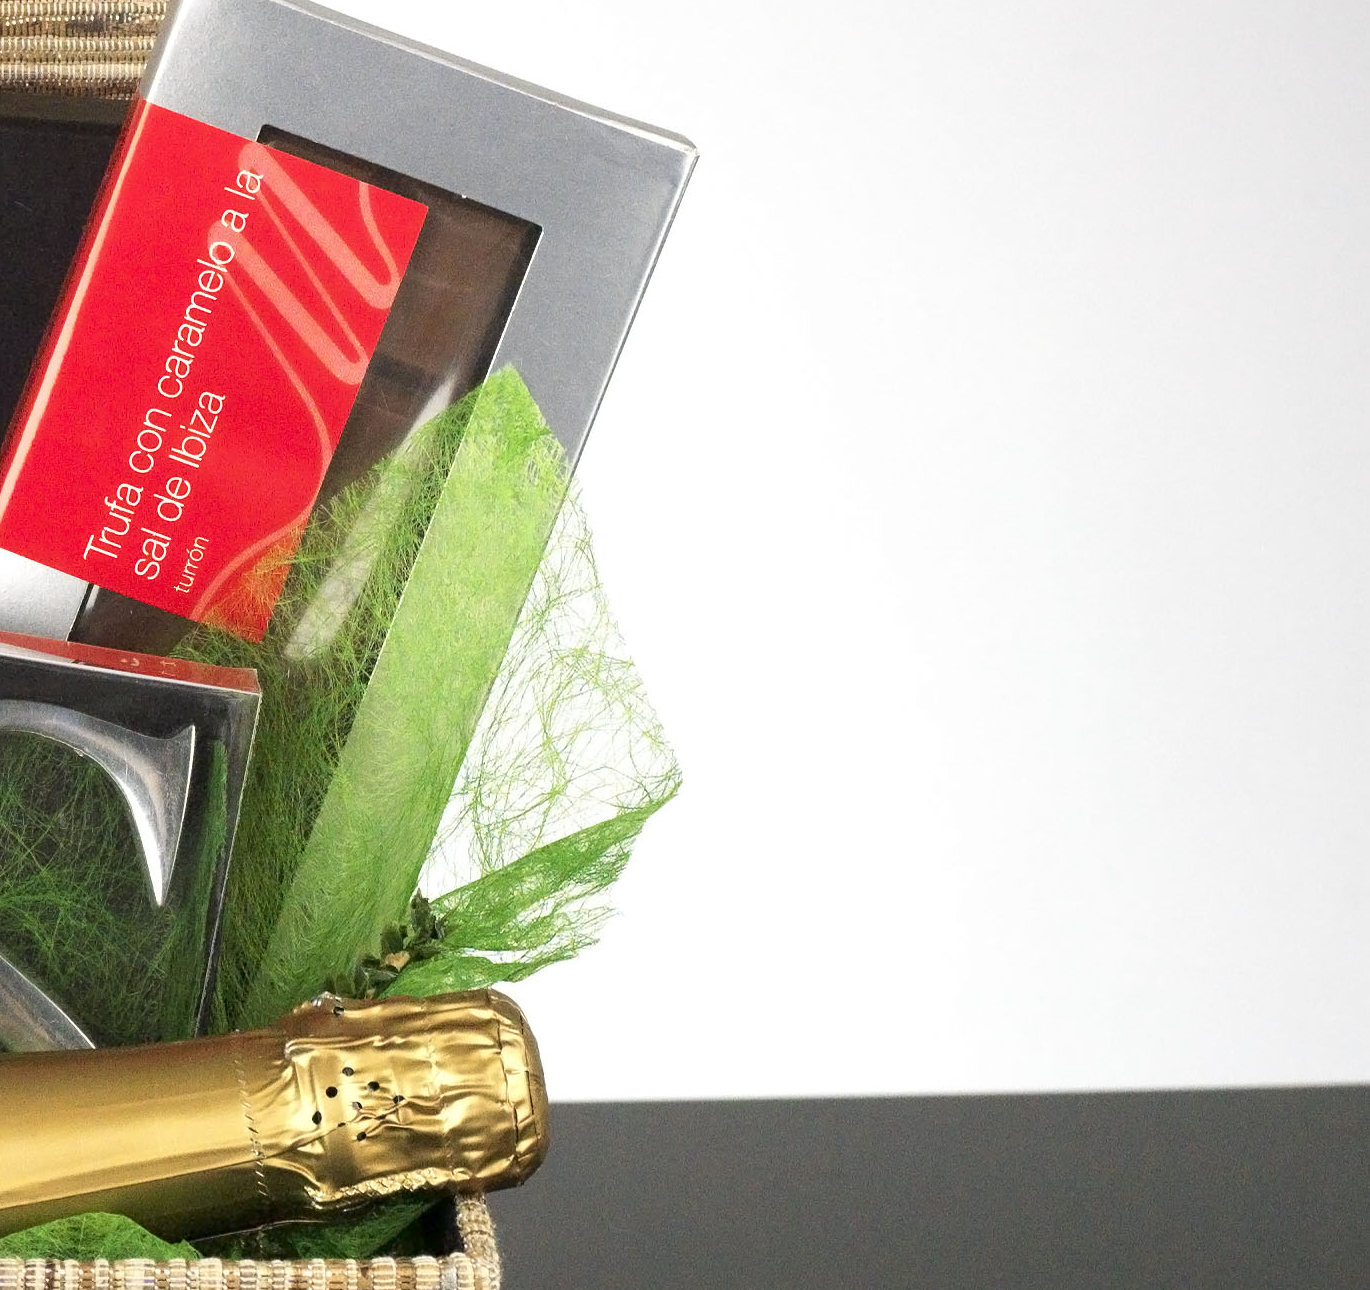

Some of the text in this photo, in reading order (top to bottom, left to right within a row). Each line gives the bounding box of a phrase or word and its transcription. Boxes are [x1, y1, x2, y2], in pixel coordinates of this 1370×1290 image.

[83, 169, 264, 560] Trufa con caramelo a la
[134, 391, 226, 580] sal de Ibiza
[173, 536, 210, 594] turrón
